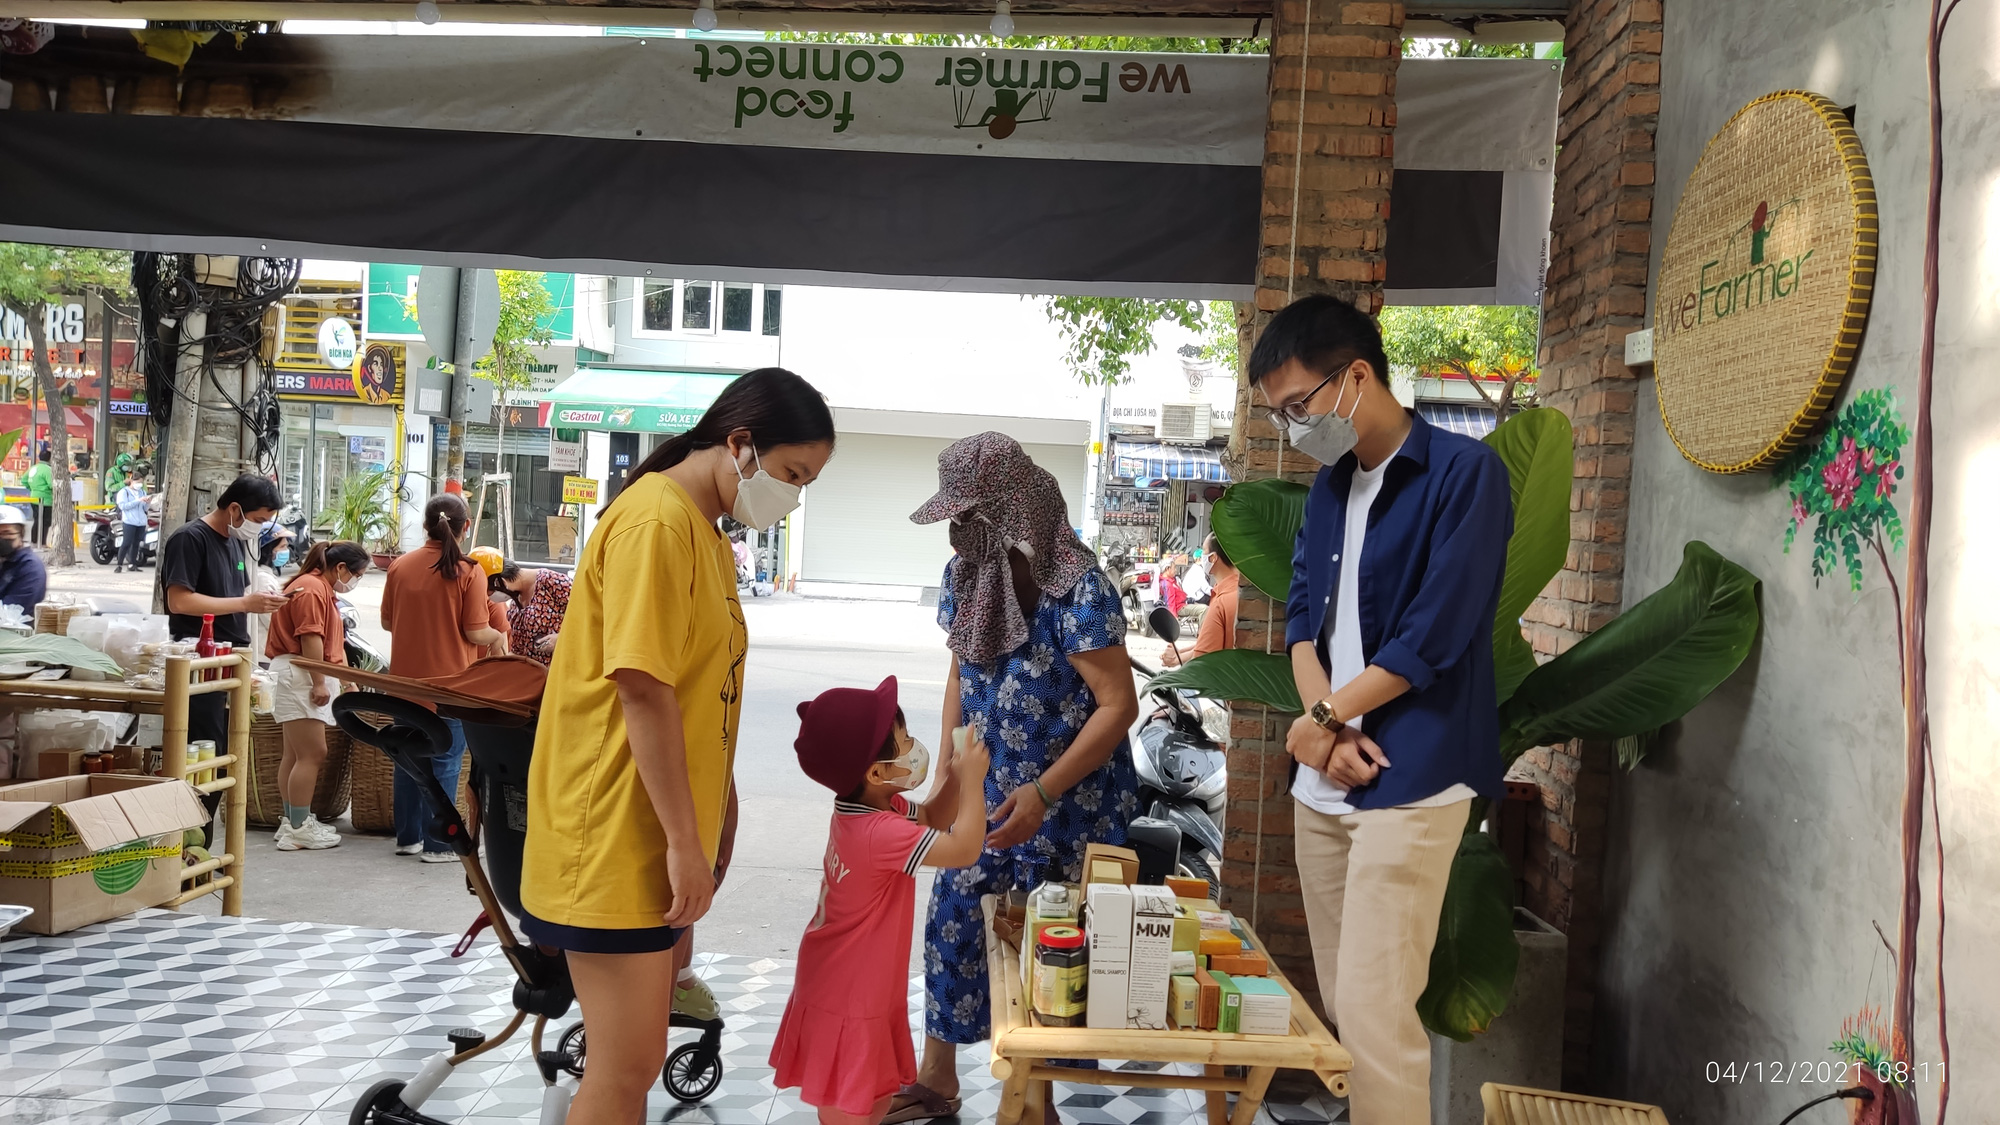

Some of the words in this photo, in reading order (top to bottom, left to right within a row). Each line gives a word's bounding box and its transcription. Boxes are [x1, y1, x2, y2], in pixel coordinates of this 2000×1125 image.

[693, 44, 904, 83] connect
[734, 86, 854, 133] food
[328, 346, 342, 358] BÍCH
[342, 349, 353, 358] NGA
[569, 411, 600, 422] Castrol
[658, 411, 677, 423] SỬA
[678, 414, 691, 424] XE
[407, 433, 424, 444] 101
[616, 455, 629, 463] 103
[1136, 922, 1171, 938] MUN
[1092, 968, 1107, 976] HERBAL
